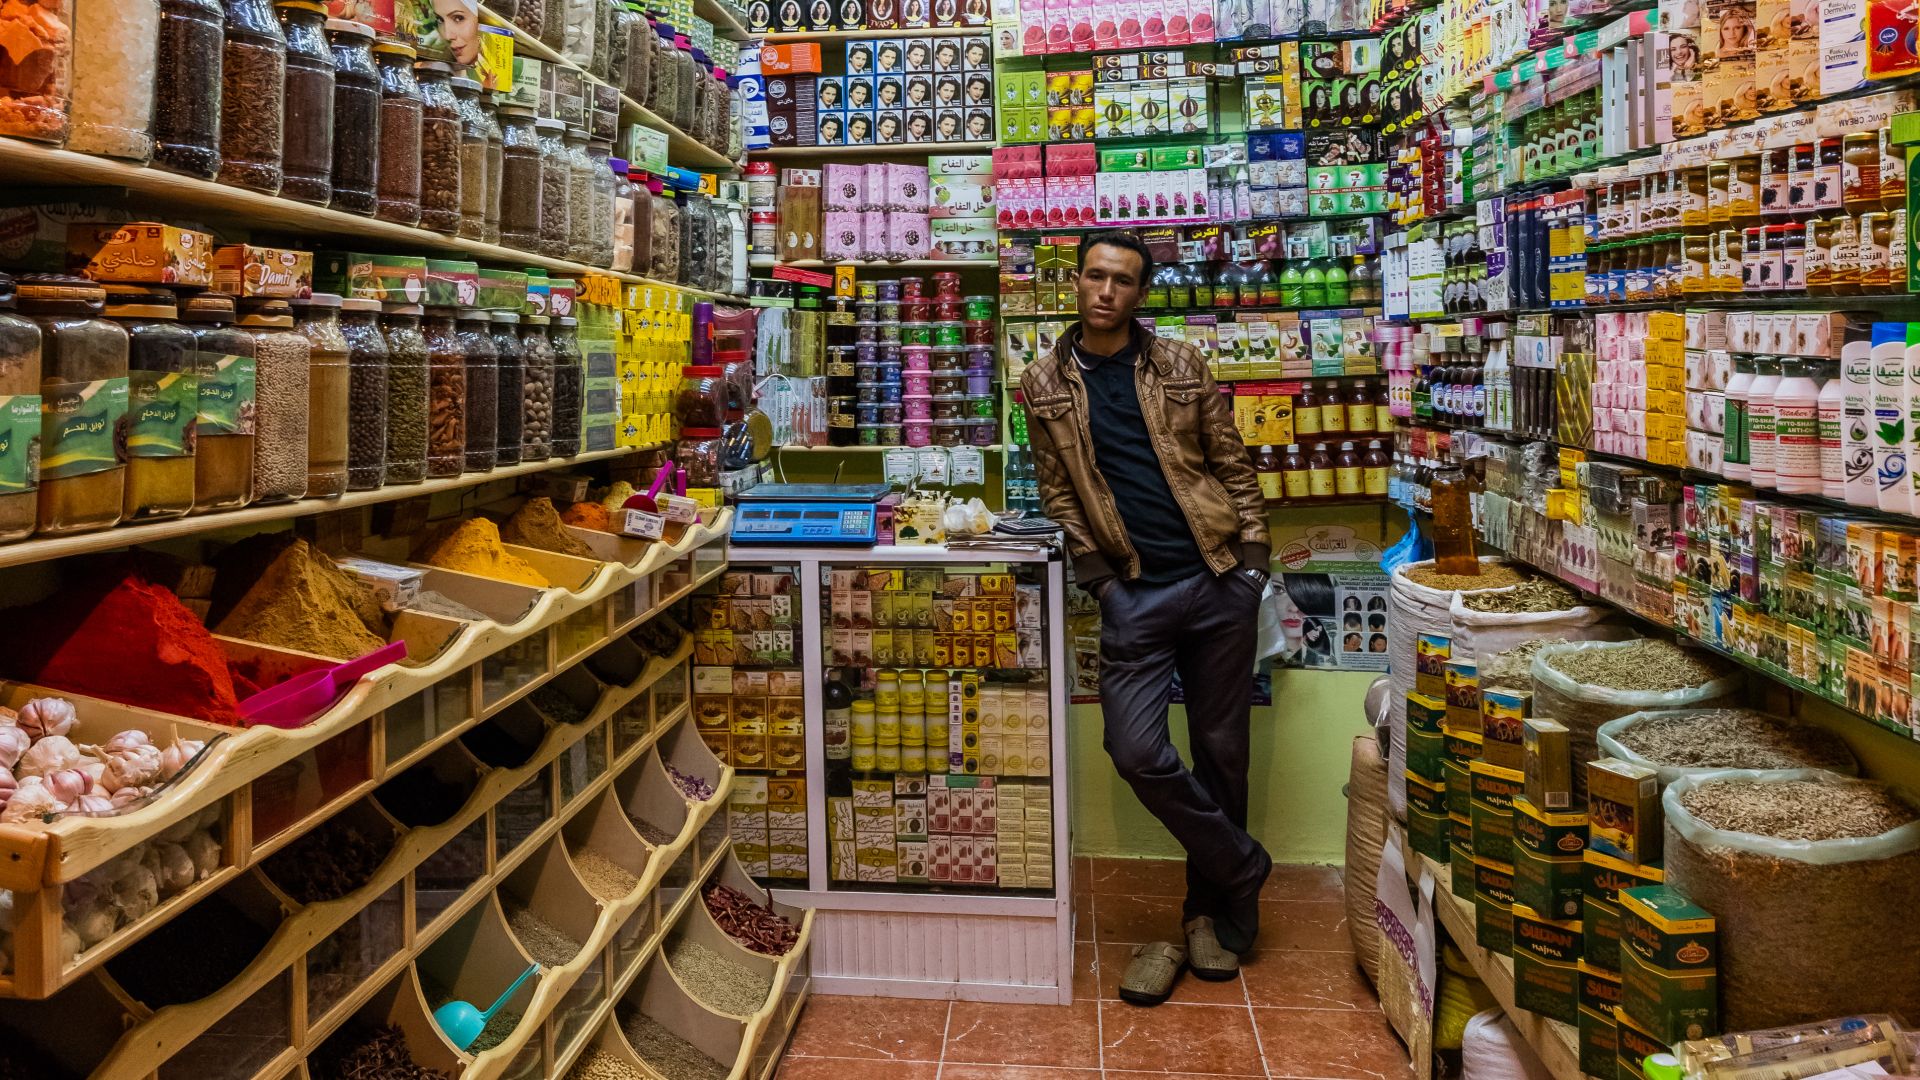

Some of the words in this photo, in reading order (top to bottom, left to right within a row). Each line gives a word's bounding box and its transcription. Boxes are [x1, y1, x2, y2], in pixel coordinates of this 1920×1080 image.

[1823, 3, 1857, 16] DermoViva
[1824, 50, 1859, 62] DermoViva
[1791, 118, 1814, 128] CREAM
[1838, 118, 1865, 128] CREAM
[1867, 112, 1888, 123] CIVIC
[940, 158, 964, 173] التفاح
[966, 159, 980, 170] خل
[948, 201, 971, 216] التفاح
[973, 201, 986, 213] خل
[934, 222, 958, 237] التفاح
[960, 222, 974, 234] خل
[102, 248, 156, 273] ضامتي
[259, 264, 293, 286] Damti
[200, 388, 220, 396] الحوت
[1875, 394, 1898, 402] Aktiva
[142, 410, 161, 421] الدجاج
[1778, 408, 1808, 416] Vitaker
[63, 422, 88, 438] اللحم
[89, 419, 105, 432] توابل
[1486, 796, 1512, 808] najma
[1490, 888, 1514, 902] najma
[1520, 922, 1573, 948] SULTAN
[1532, 942, 1562, 958] najma
